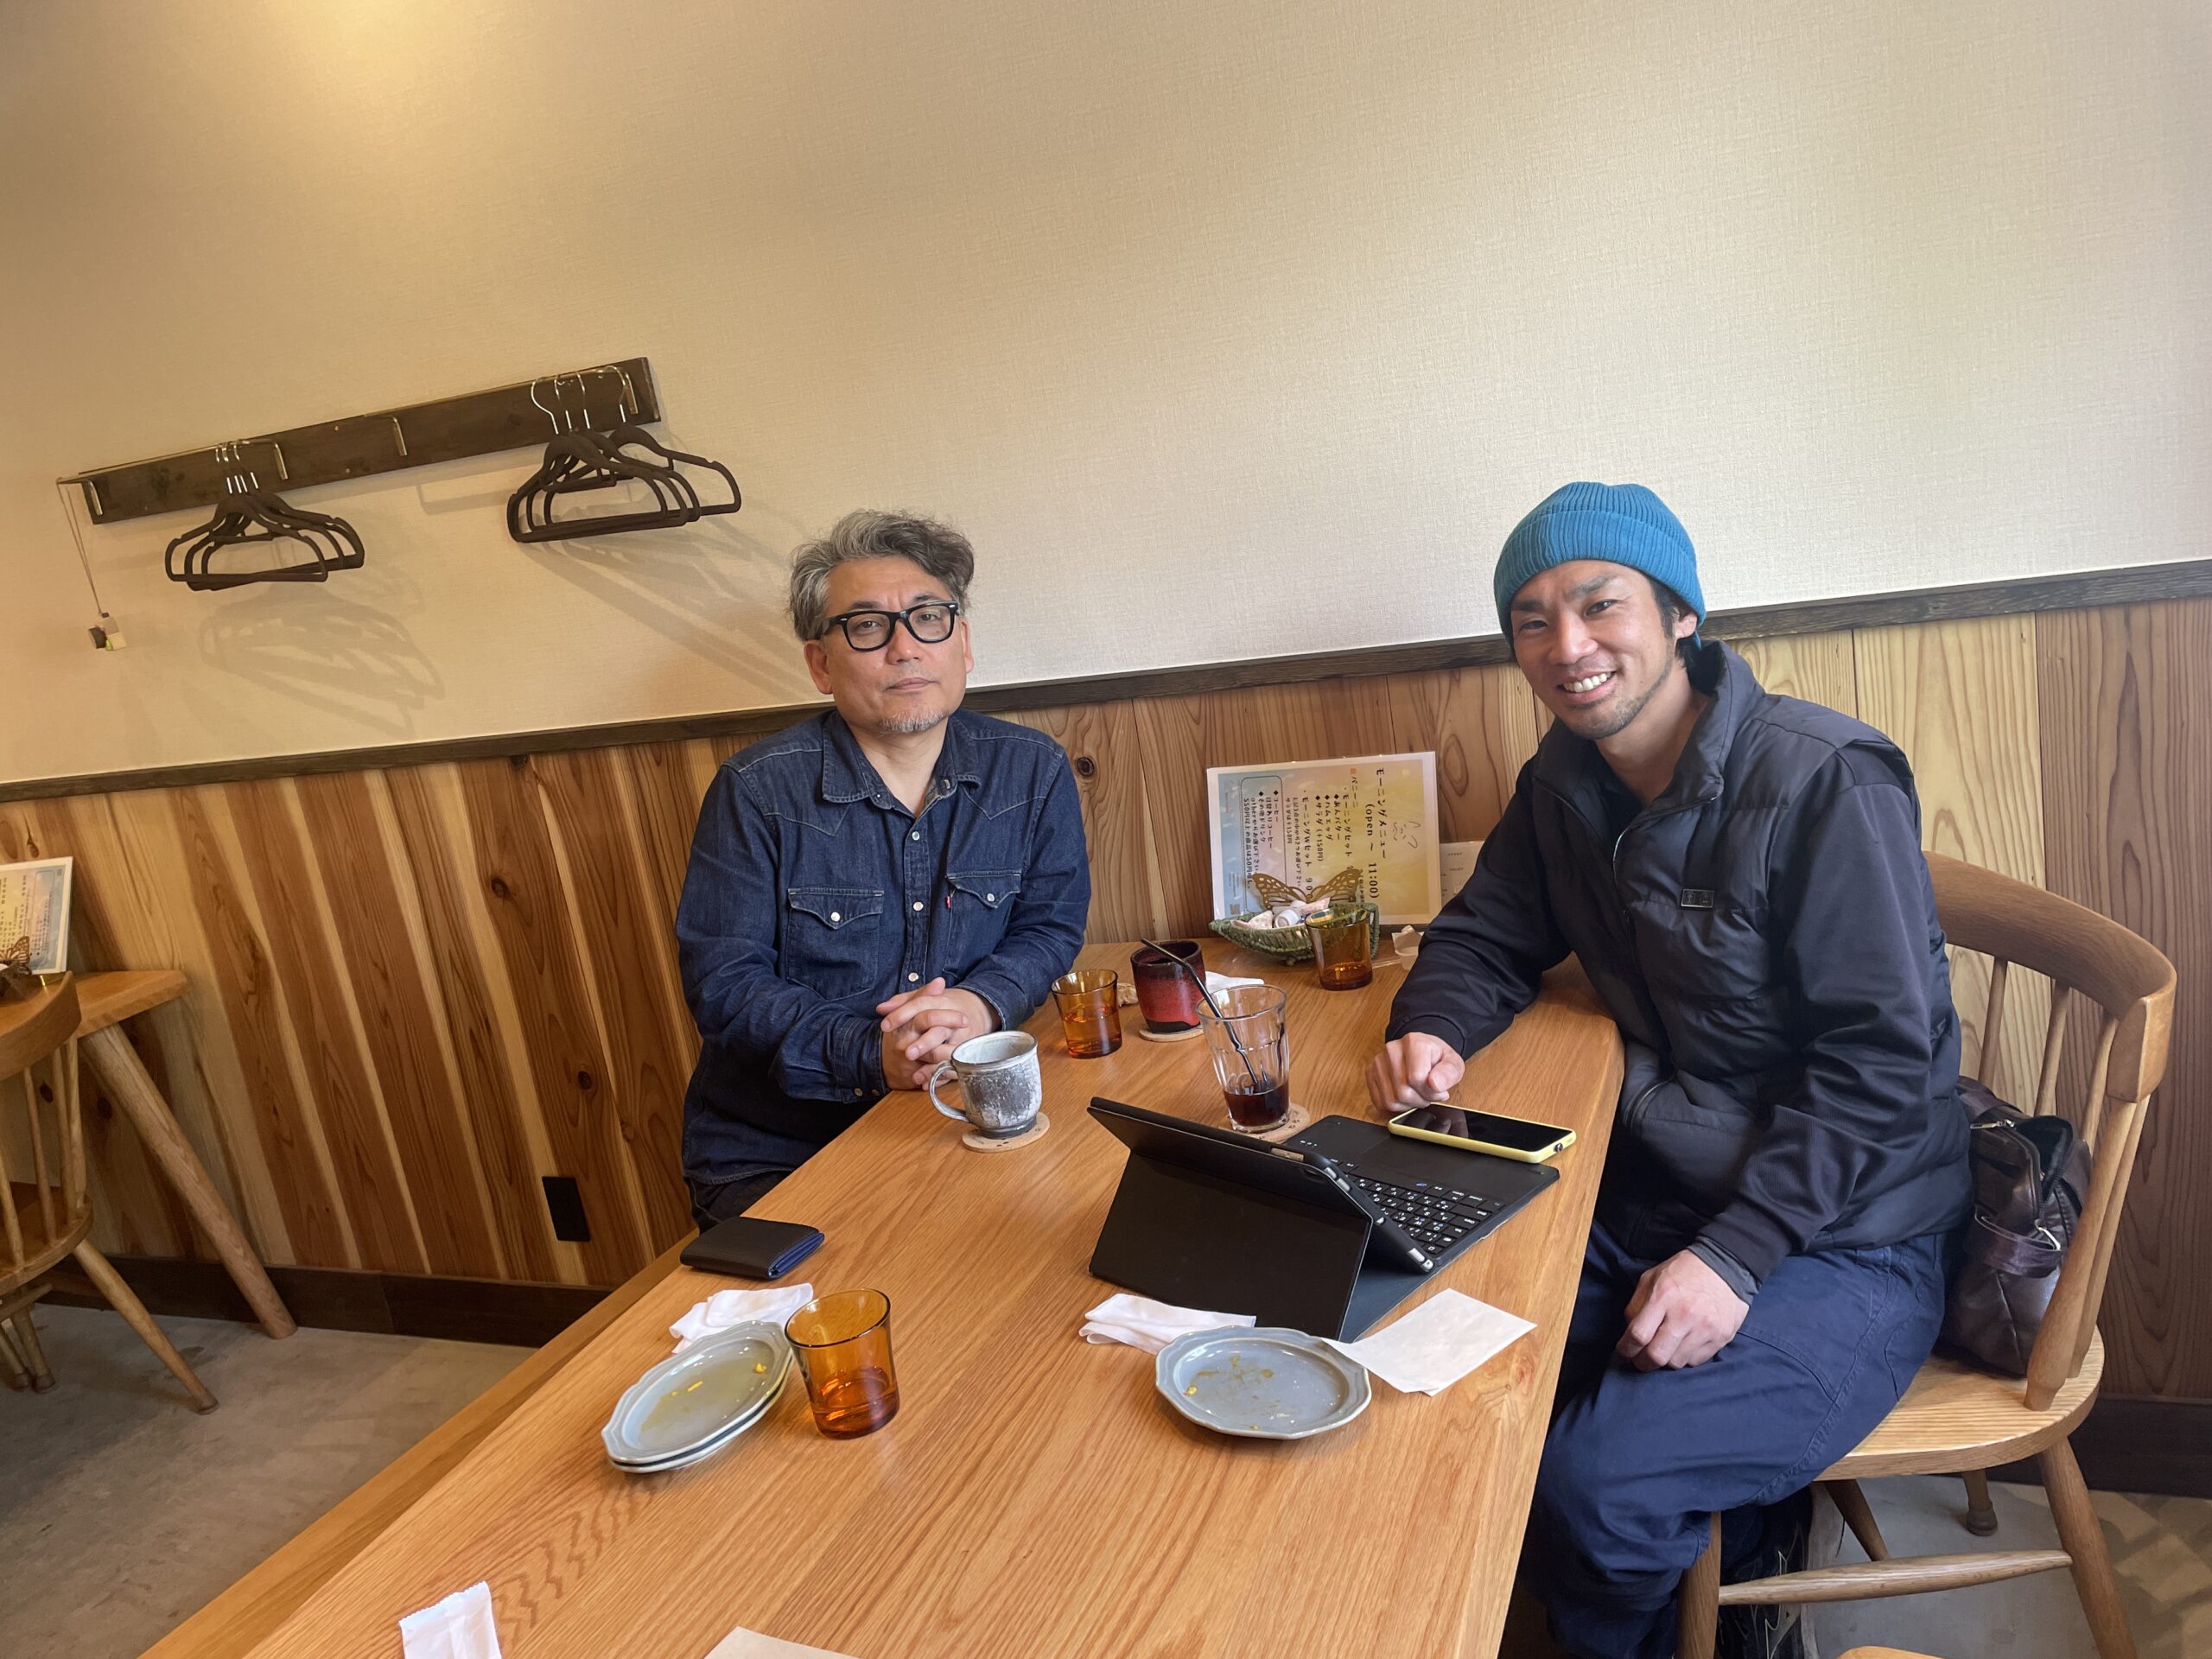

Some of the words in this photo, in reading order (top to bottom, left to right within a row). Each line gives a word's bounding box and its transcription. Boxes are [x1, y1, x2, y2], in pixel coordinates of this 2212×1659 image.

[1351, 776, 1359, 809] パニーニ
[1364, 804, 1375, 836] (open
[1376, 766, 1388, 859] モーニングメニュー
[1367, 862, 1379, 899] 11:00)
